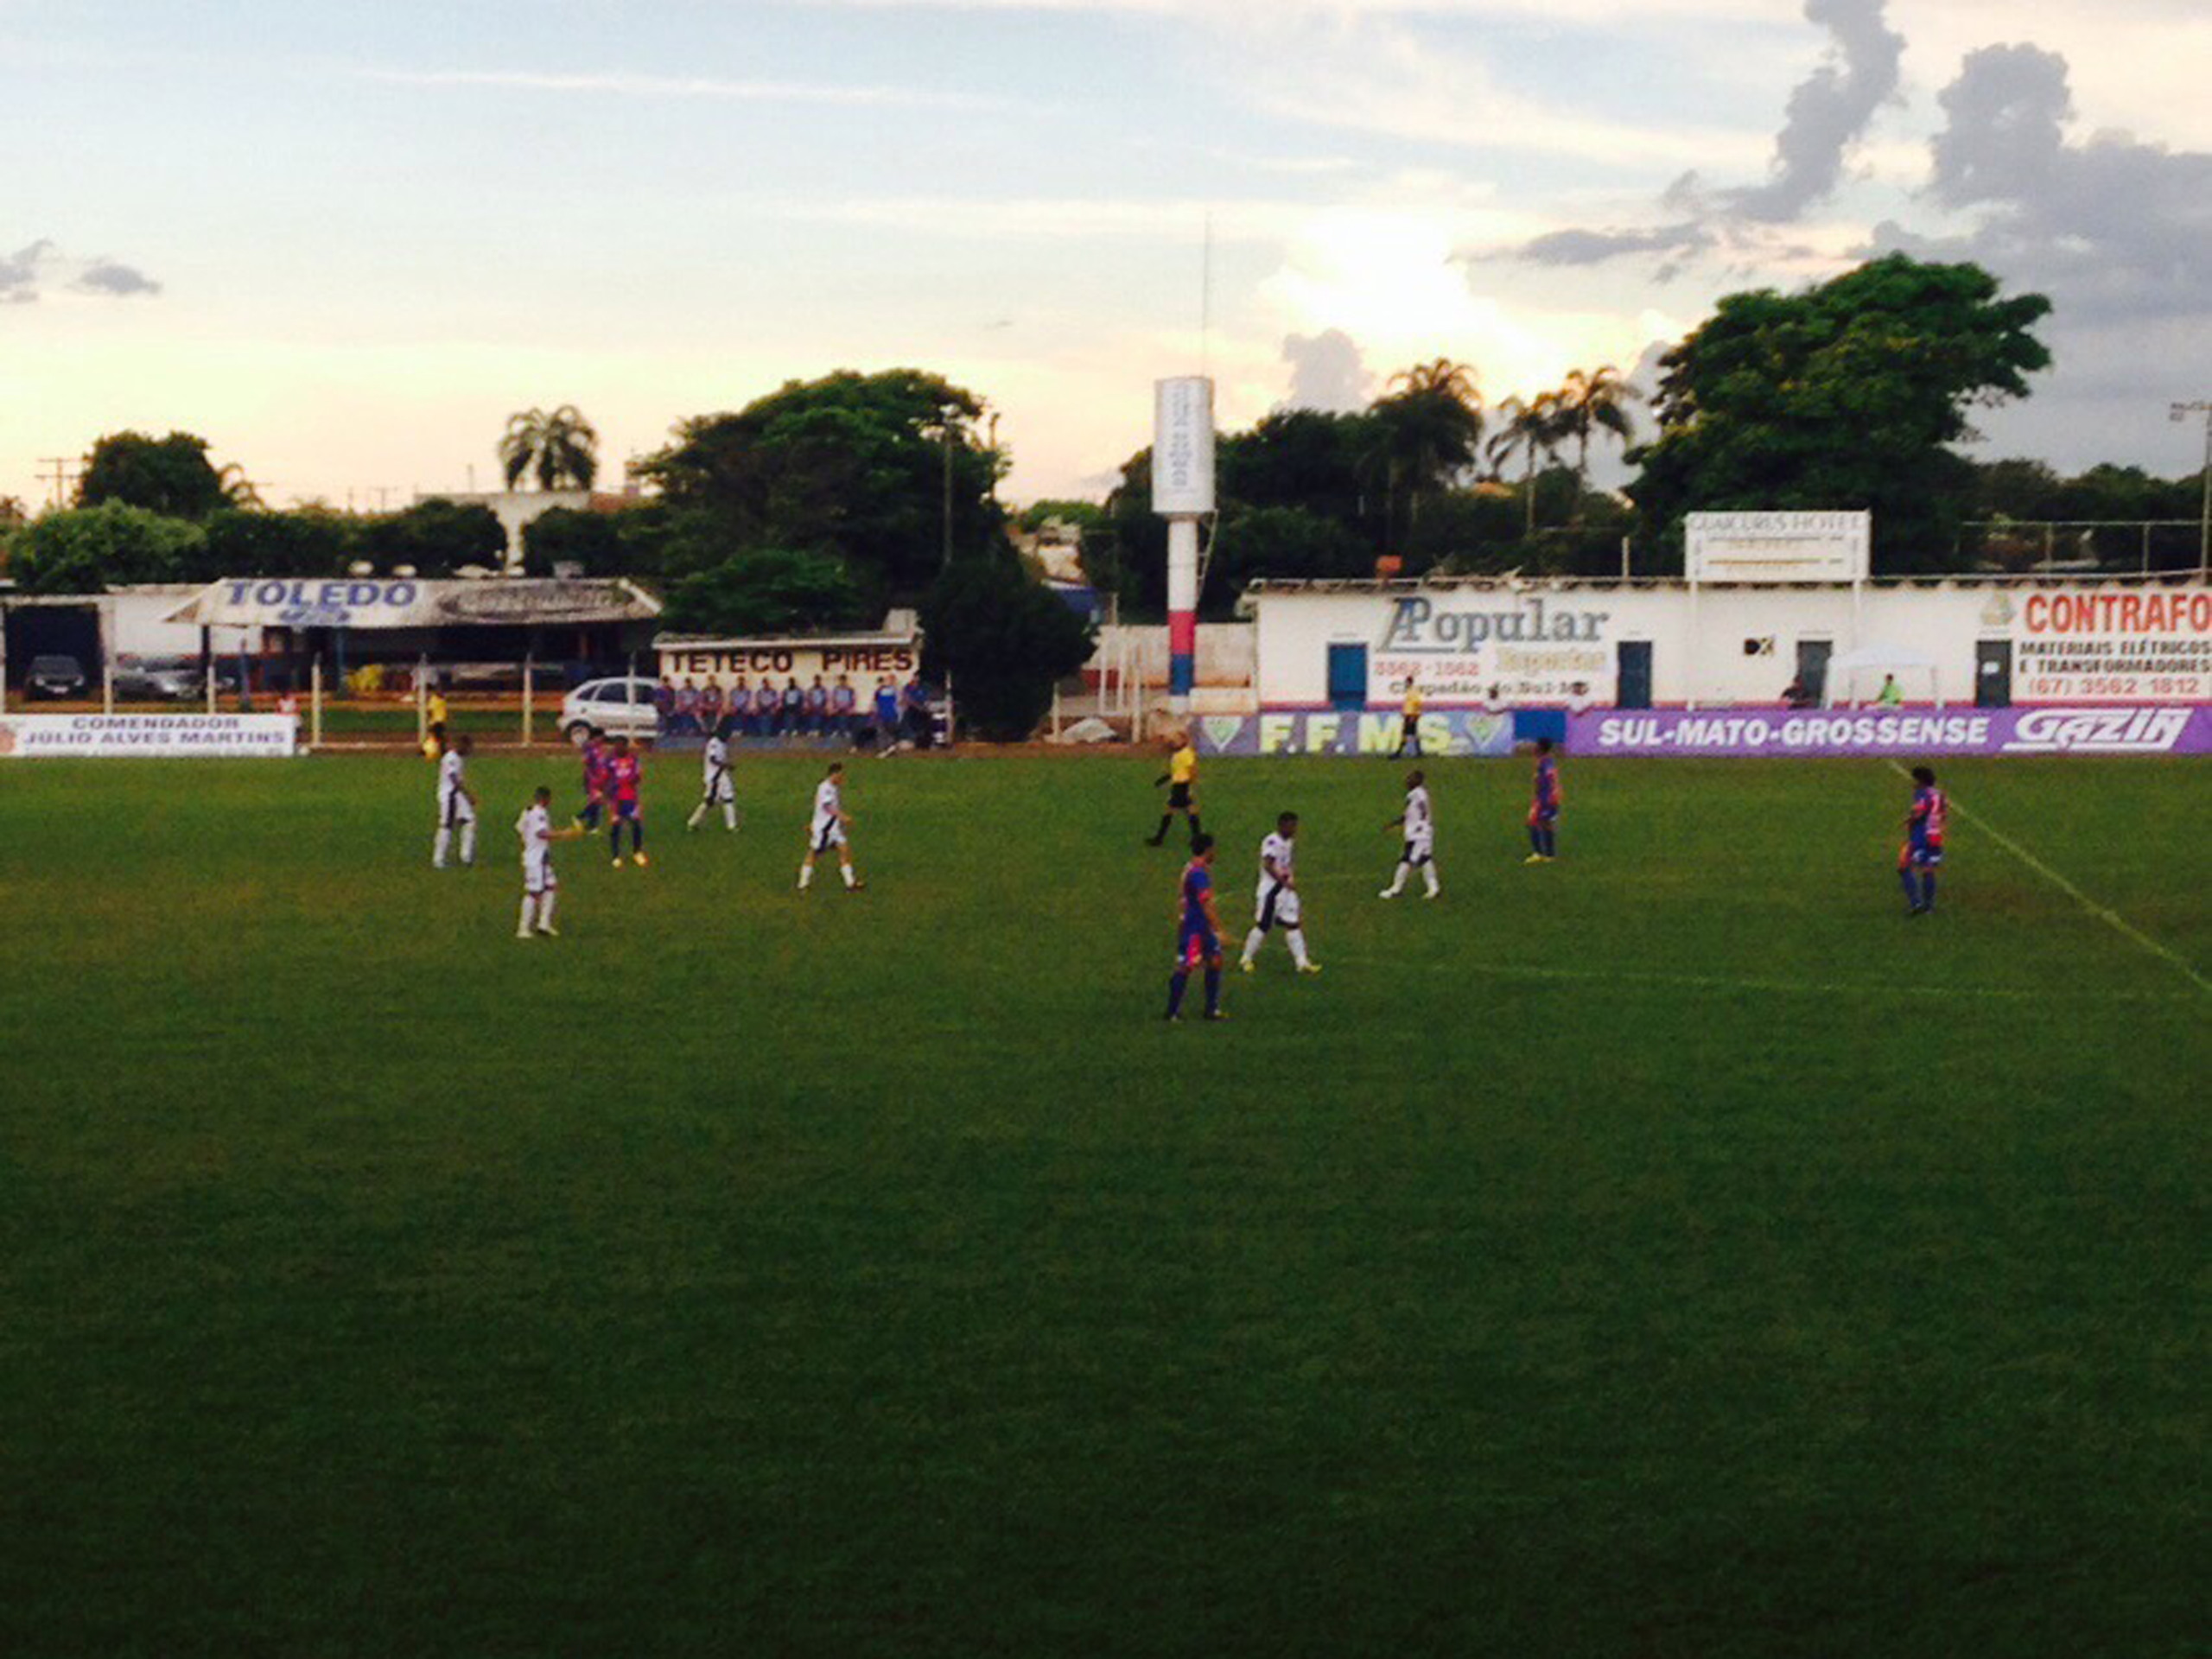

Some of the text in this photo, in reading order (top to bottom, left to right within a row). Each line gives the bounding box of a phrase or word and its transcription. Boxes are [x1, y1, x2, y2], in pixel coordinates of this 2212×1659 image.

[228, 581, 416, 607] TOLEDO
[2026, 592, 2212, 634] CONTRAFO
[2019, 639, 2113, 655] MATERIAIS
[671, 649, 913, 673] TETECO PIRES
[2038, 658, 2210, 673] TRANSFORMADORES
[2031, 678, 2070, 695] (67)
[73, 716, 239, 729] COMENDADOR
[1599, 717, 1990, 747] SUL-MATO-GROSSENSE
[2003, 709, 2195, 751] GAZIN
[101, 733, 170, 744] ALVES
[180, 732, 285, 744] MARTINS
